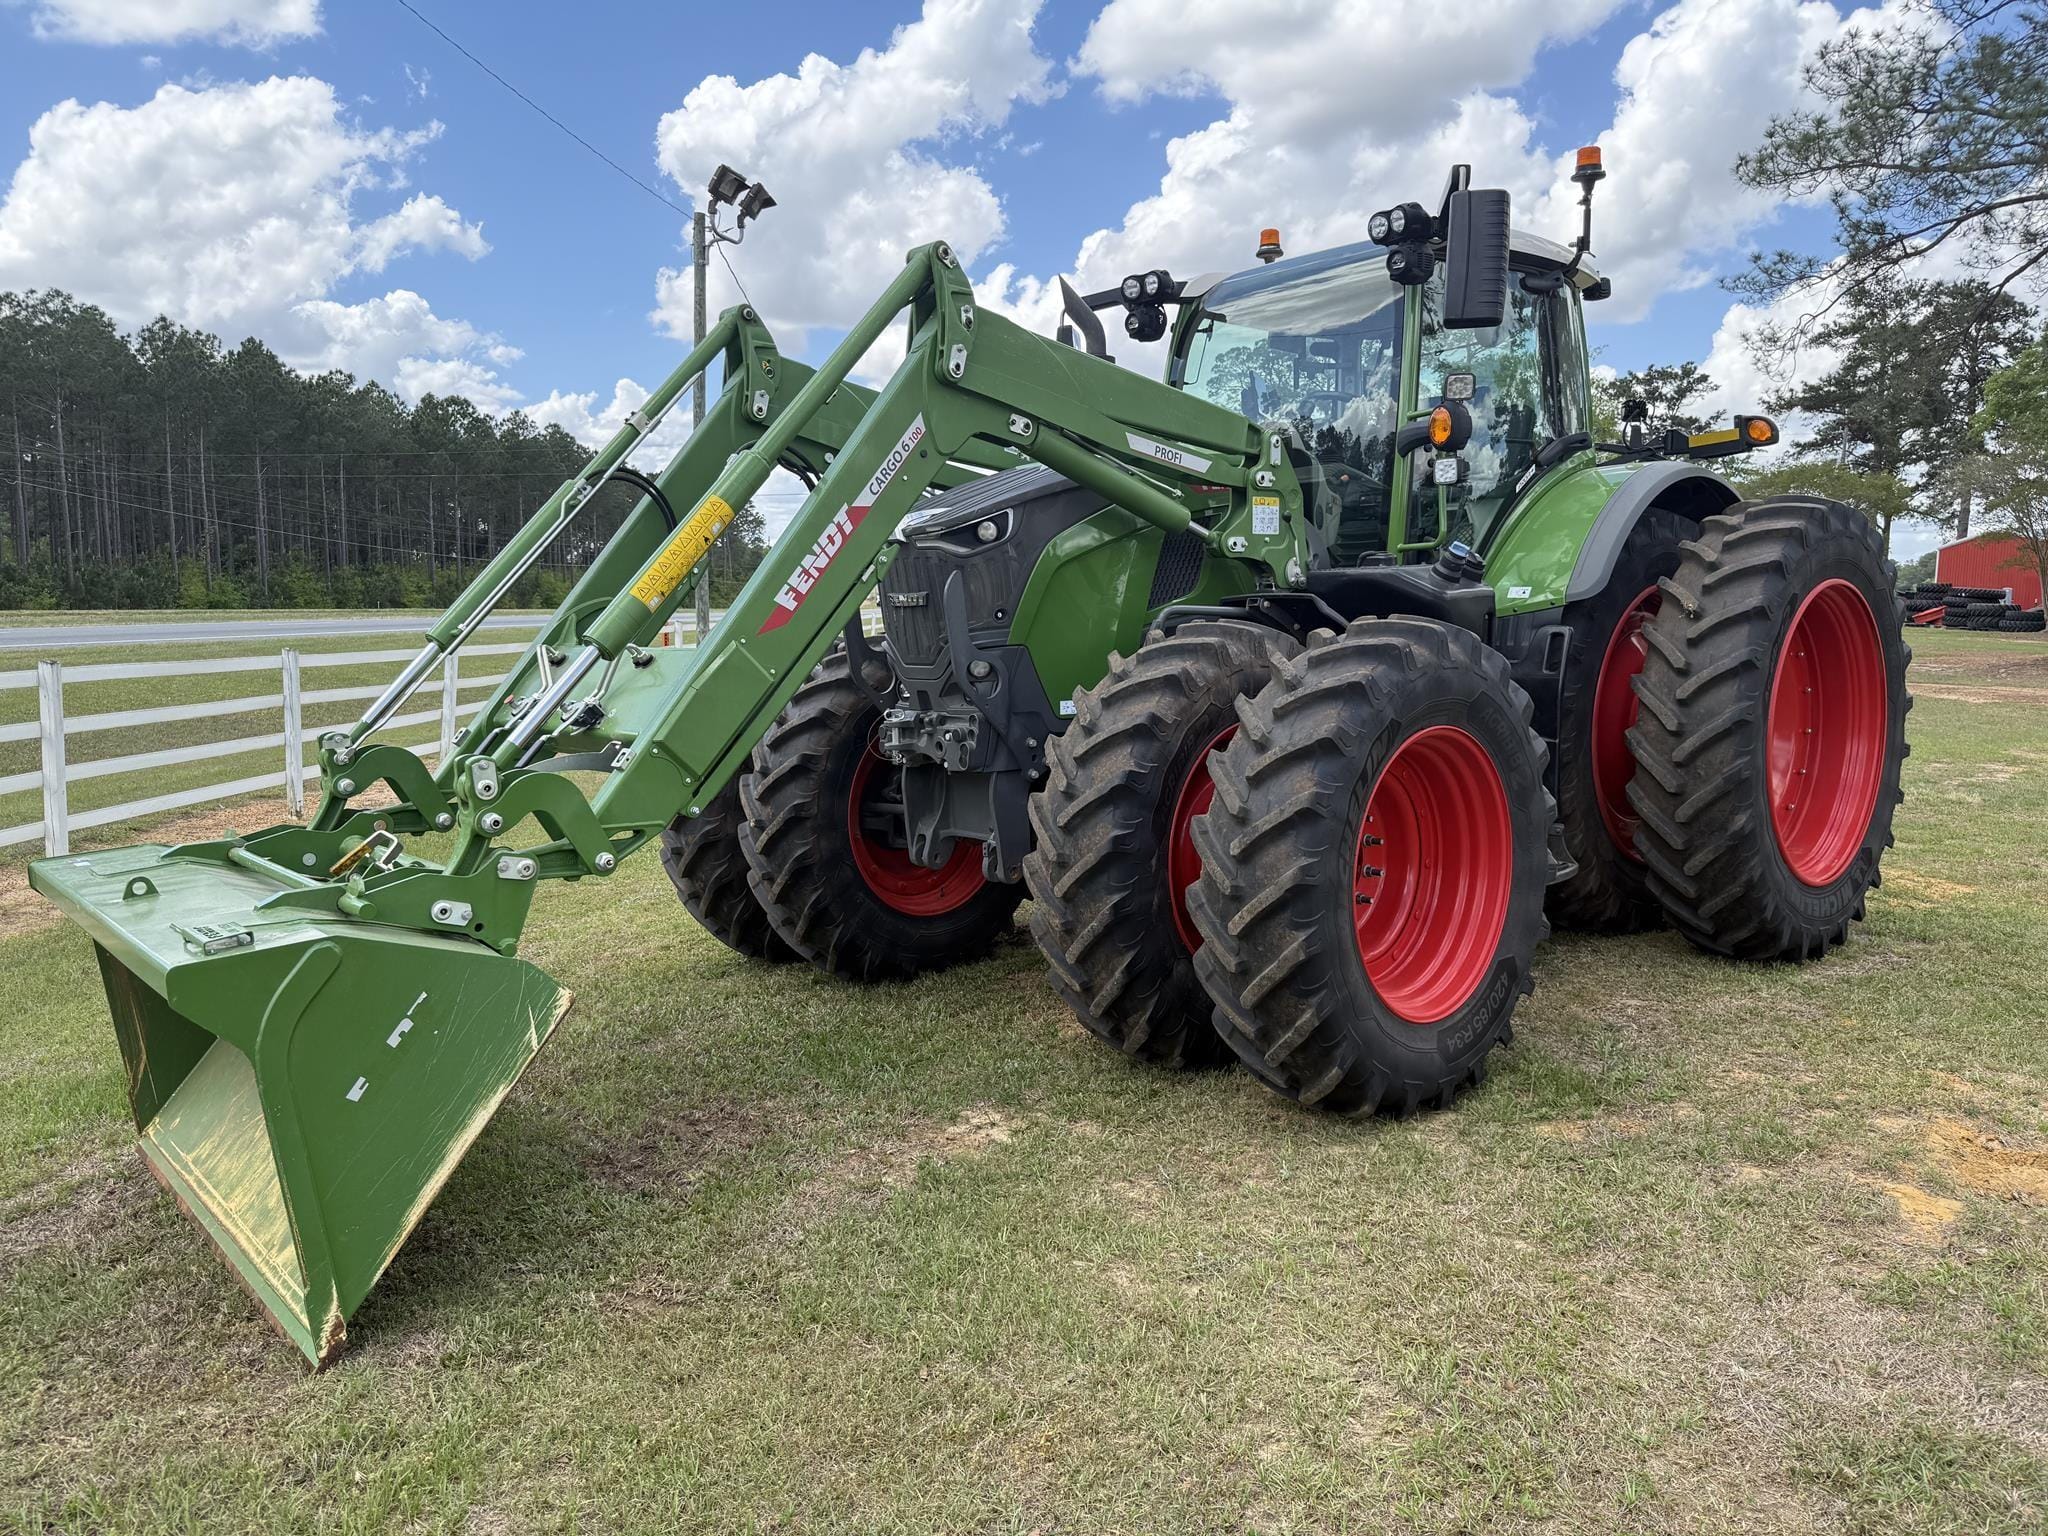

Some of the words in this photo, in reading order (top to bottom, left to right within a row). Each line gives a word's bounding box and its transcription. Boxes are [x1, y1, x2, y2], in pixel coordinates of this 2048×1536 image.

[869, 450, 903, 496] CARGO
[1155, 445, 1183, 465] PROFI
[774, 502, 855, 612] FENDT
